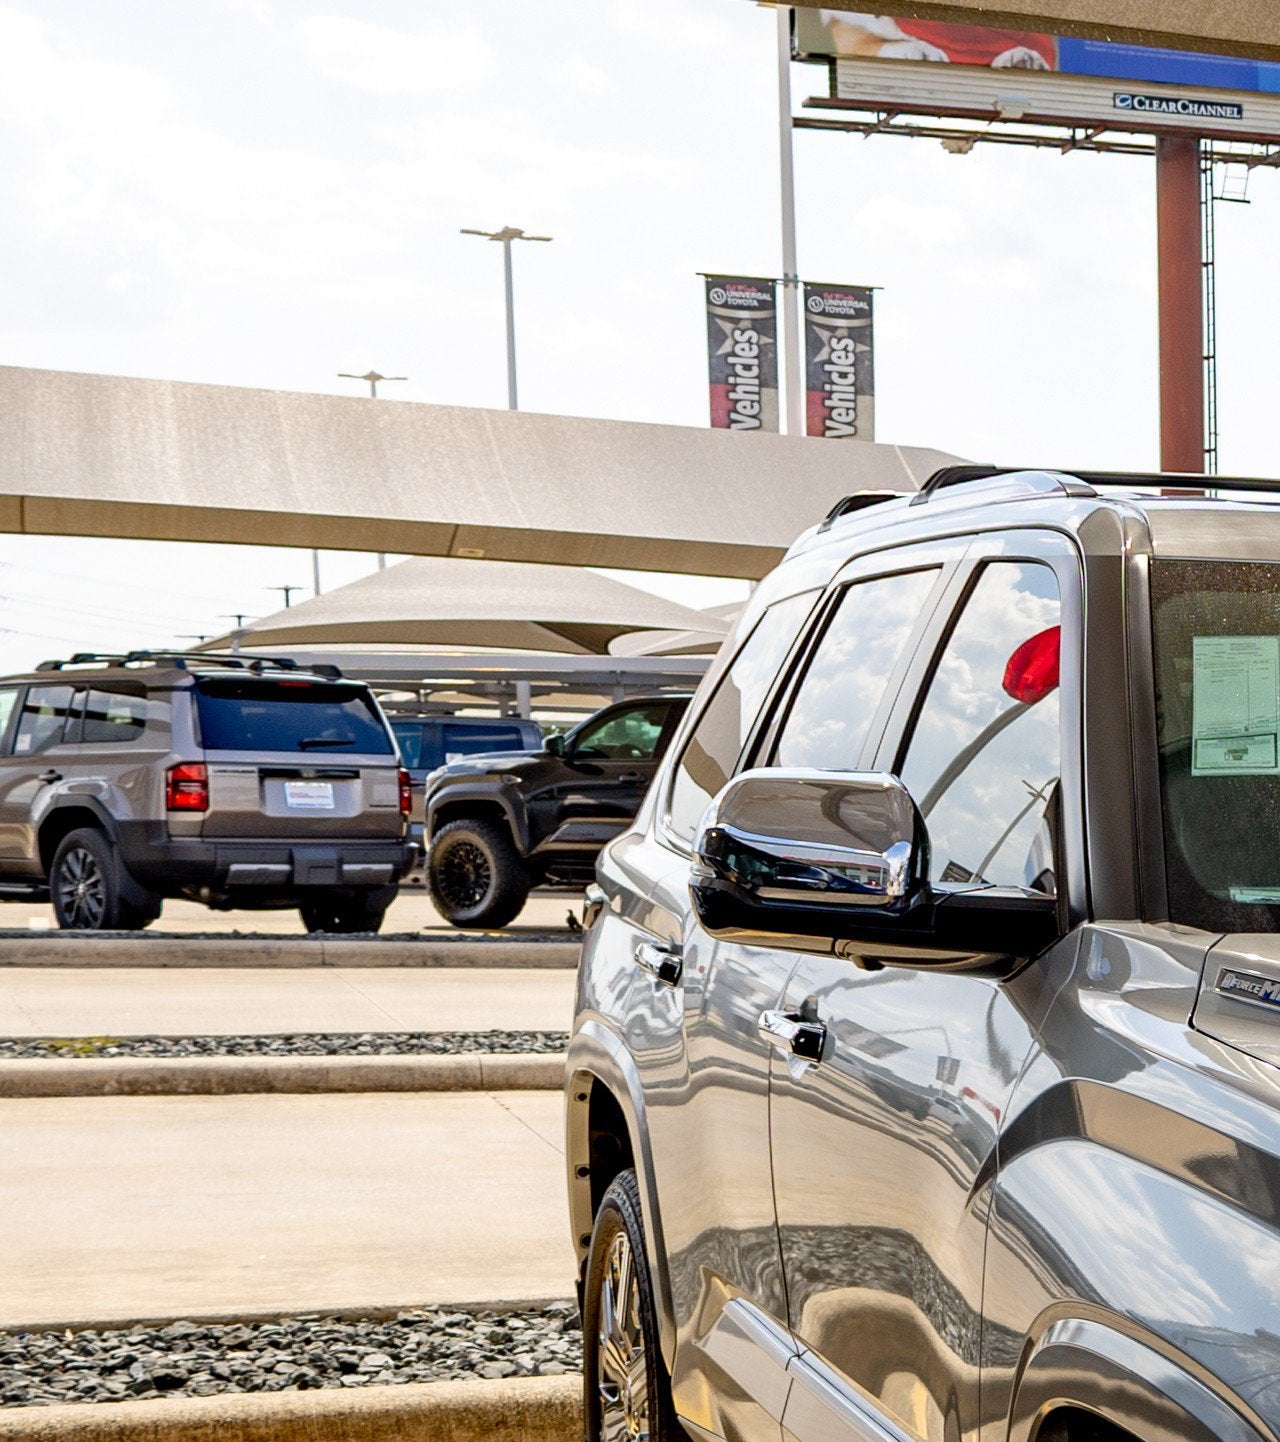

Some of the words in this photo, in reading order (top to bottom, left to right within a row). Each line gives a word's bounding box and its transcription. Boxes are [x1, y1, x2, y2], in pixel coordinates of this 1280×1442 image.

[726, 290, 772, 301] UNIVERSAL
[726, 298, 759, 307] TOYOTA
[824, 299, 869, 310] UNIVERSAL
[825, 306, 856, 315] TOYOTA
[727, 329, 760, 430] Vehicles
[824, 337, 856, 438] Vehicles
